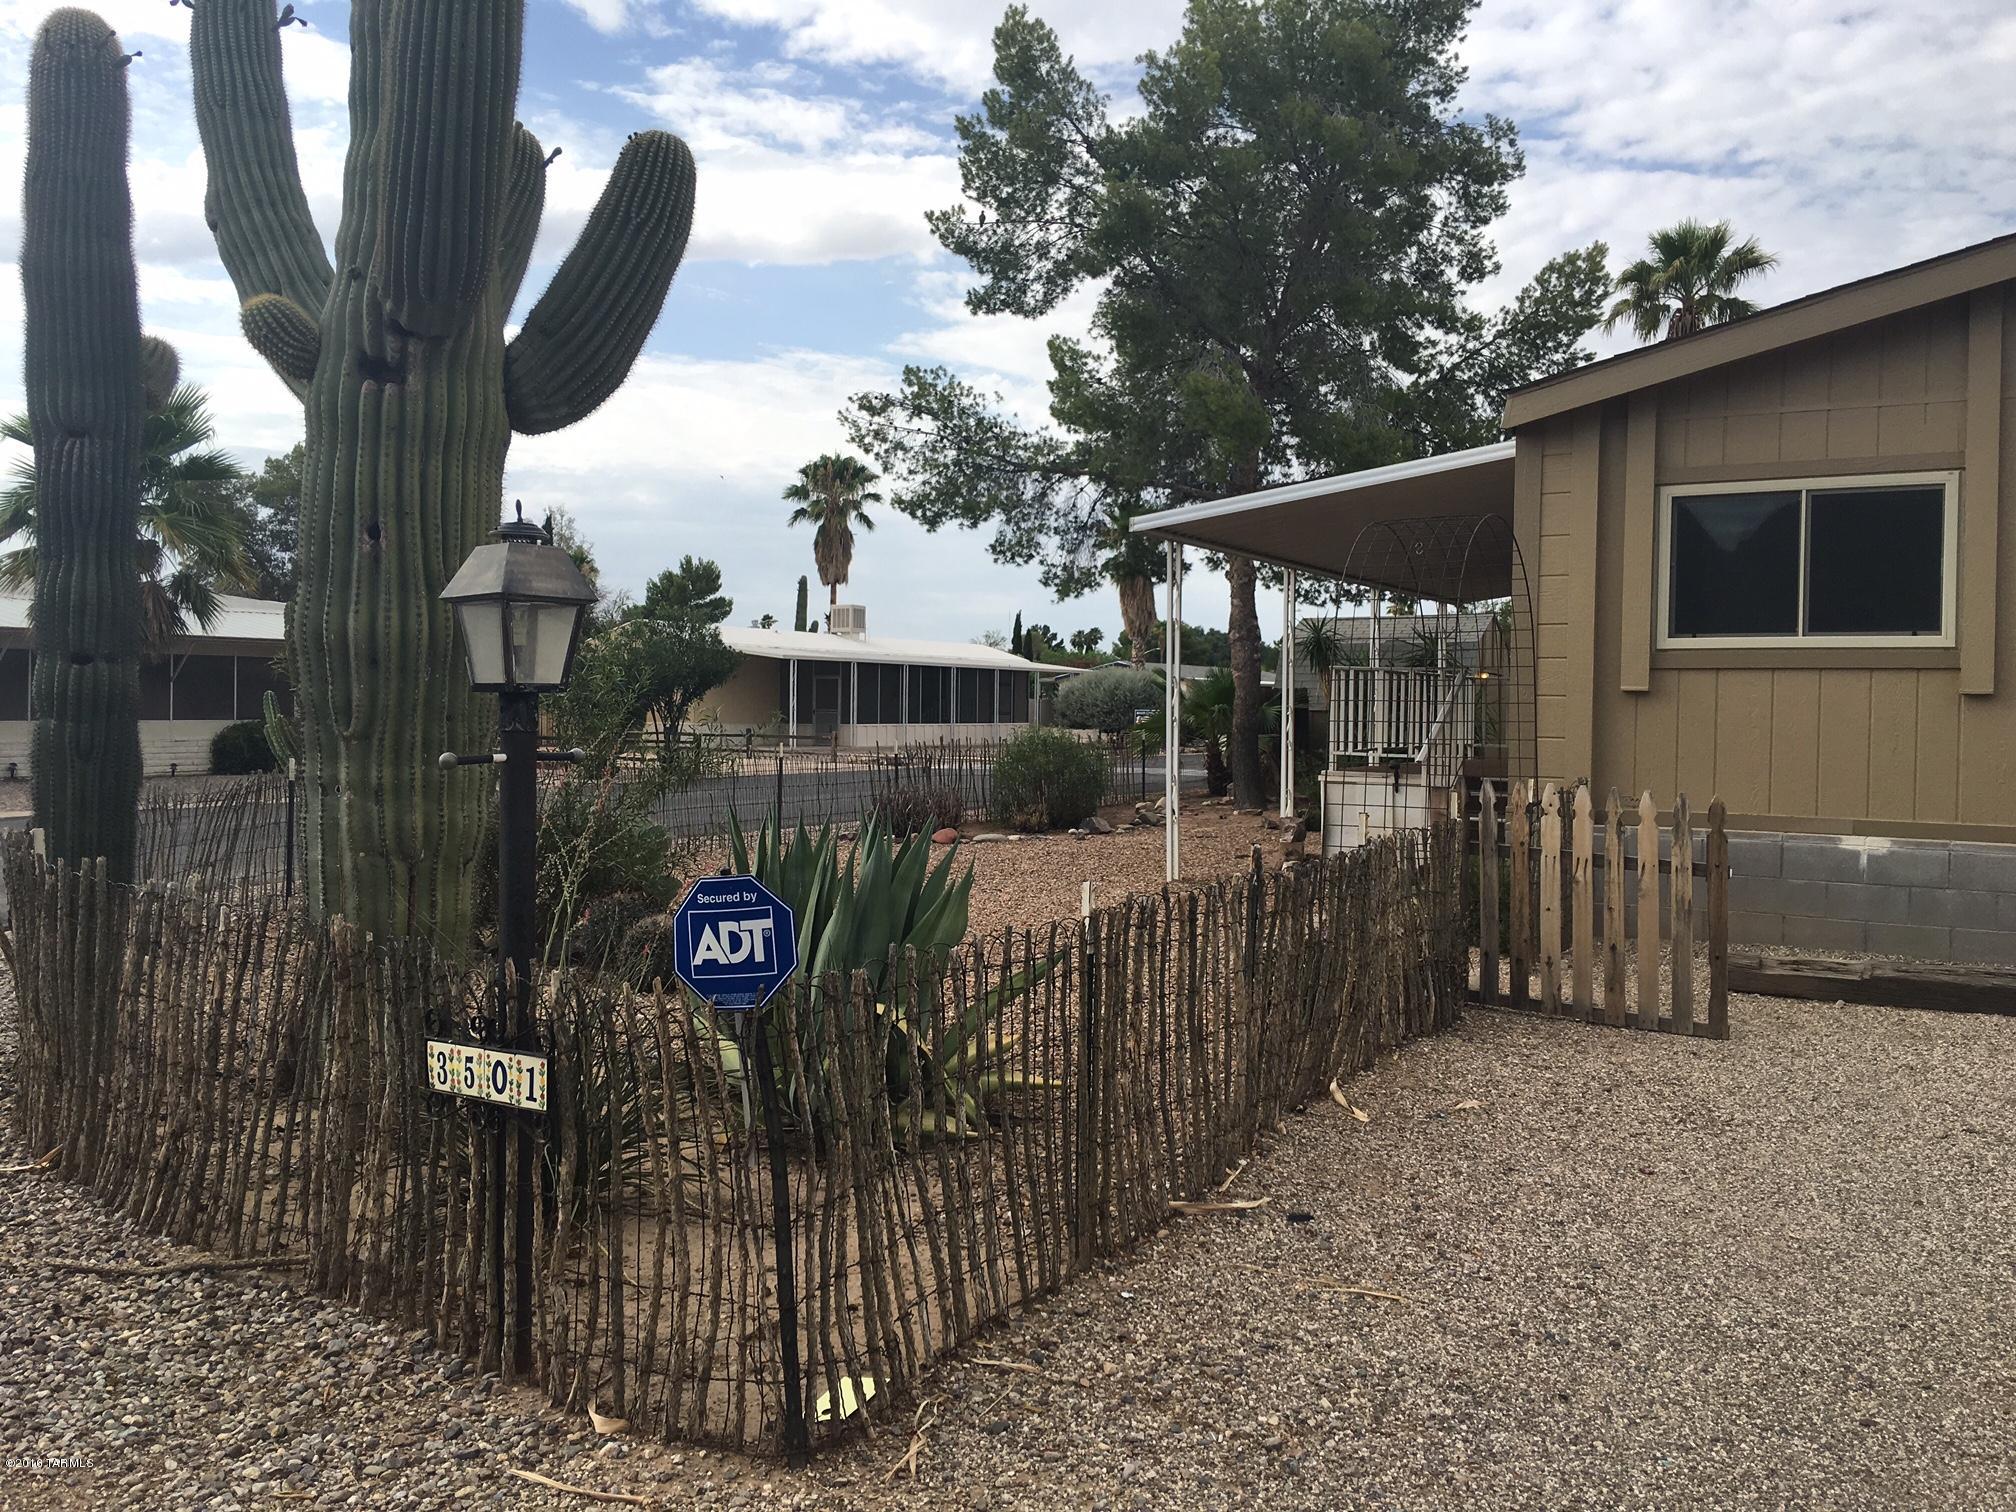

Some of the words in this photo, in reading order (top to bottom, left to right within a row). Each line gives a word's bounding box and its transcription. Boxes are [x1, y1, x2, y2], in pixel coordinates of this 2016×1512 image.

[697, 892, 740, 904] Secured
[743, 891, 757, 902] by
[693, 918, 773, 966] ADT
[437, 1051, 538, 1103] 3501
